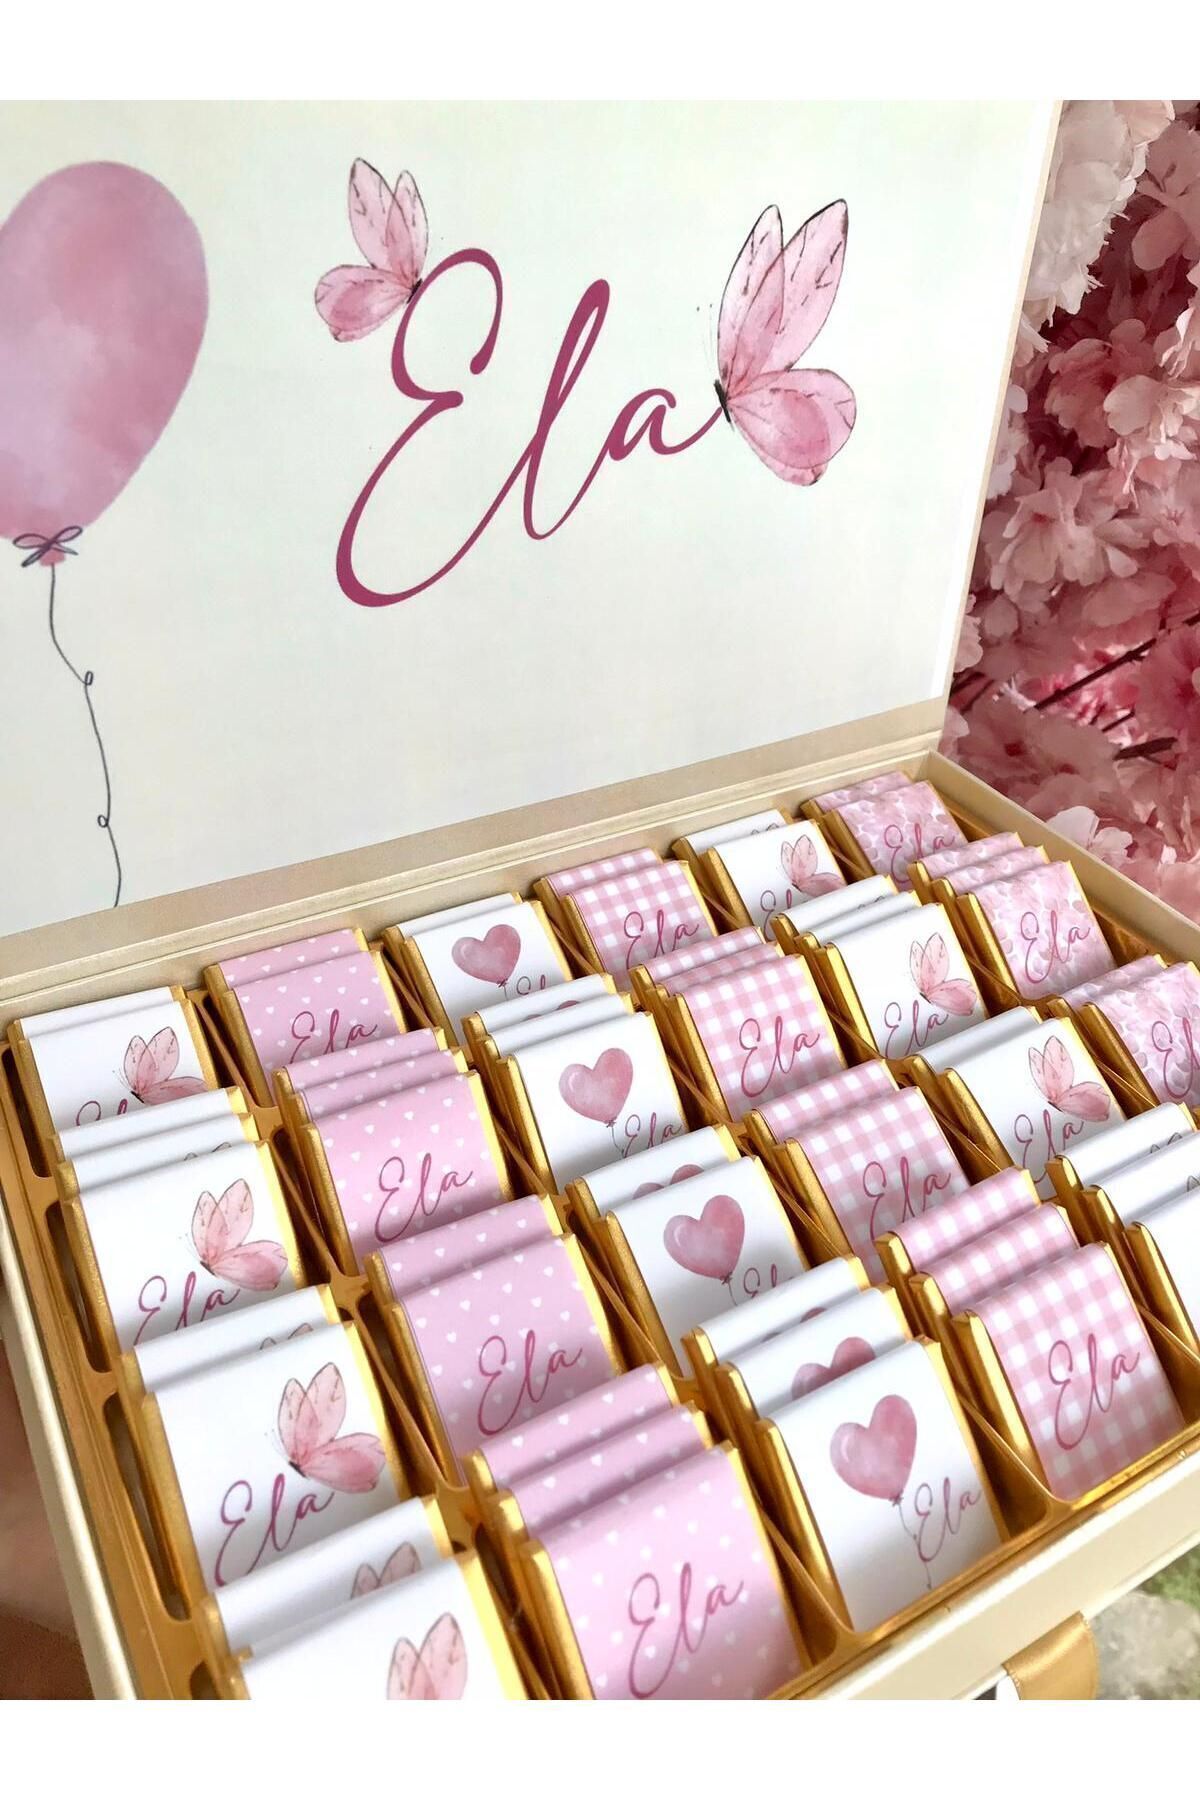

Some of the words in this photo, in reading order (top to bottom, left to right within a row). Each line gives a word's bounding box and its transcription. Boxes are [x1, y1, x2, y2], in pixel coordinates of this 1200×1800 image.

[336, 248, 722, 607] Ela
[883, 823, 955, 883] Ela
[623, 909, 699, 970] Ela
[1020, 910, 1090, 984] Ela
[290, 1009, 378, 1064] Ela
[739, 1016, 820, 1097] Ela
[884, 1000, 949, 1059] Ela
[1151, 1017, 1200, 1099] El
[624, 1112, 682, 1158] Ela
[1014, 1109, 1084, 1183] Ela
[375, 1153, 473, 1243] Ela
[863, 1156, 951, 1241] Ela
[134, 1271, 240, 1346] Ela
[478, 1329, 583, 1436] Ela
[1048, 1333, 1140, 1450] Ela
[214, 1473, 334, 1587] Ela
[914, 1476, 982, 1562] Ela
[628, 1562, 744, 1699] Ela
